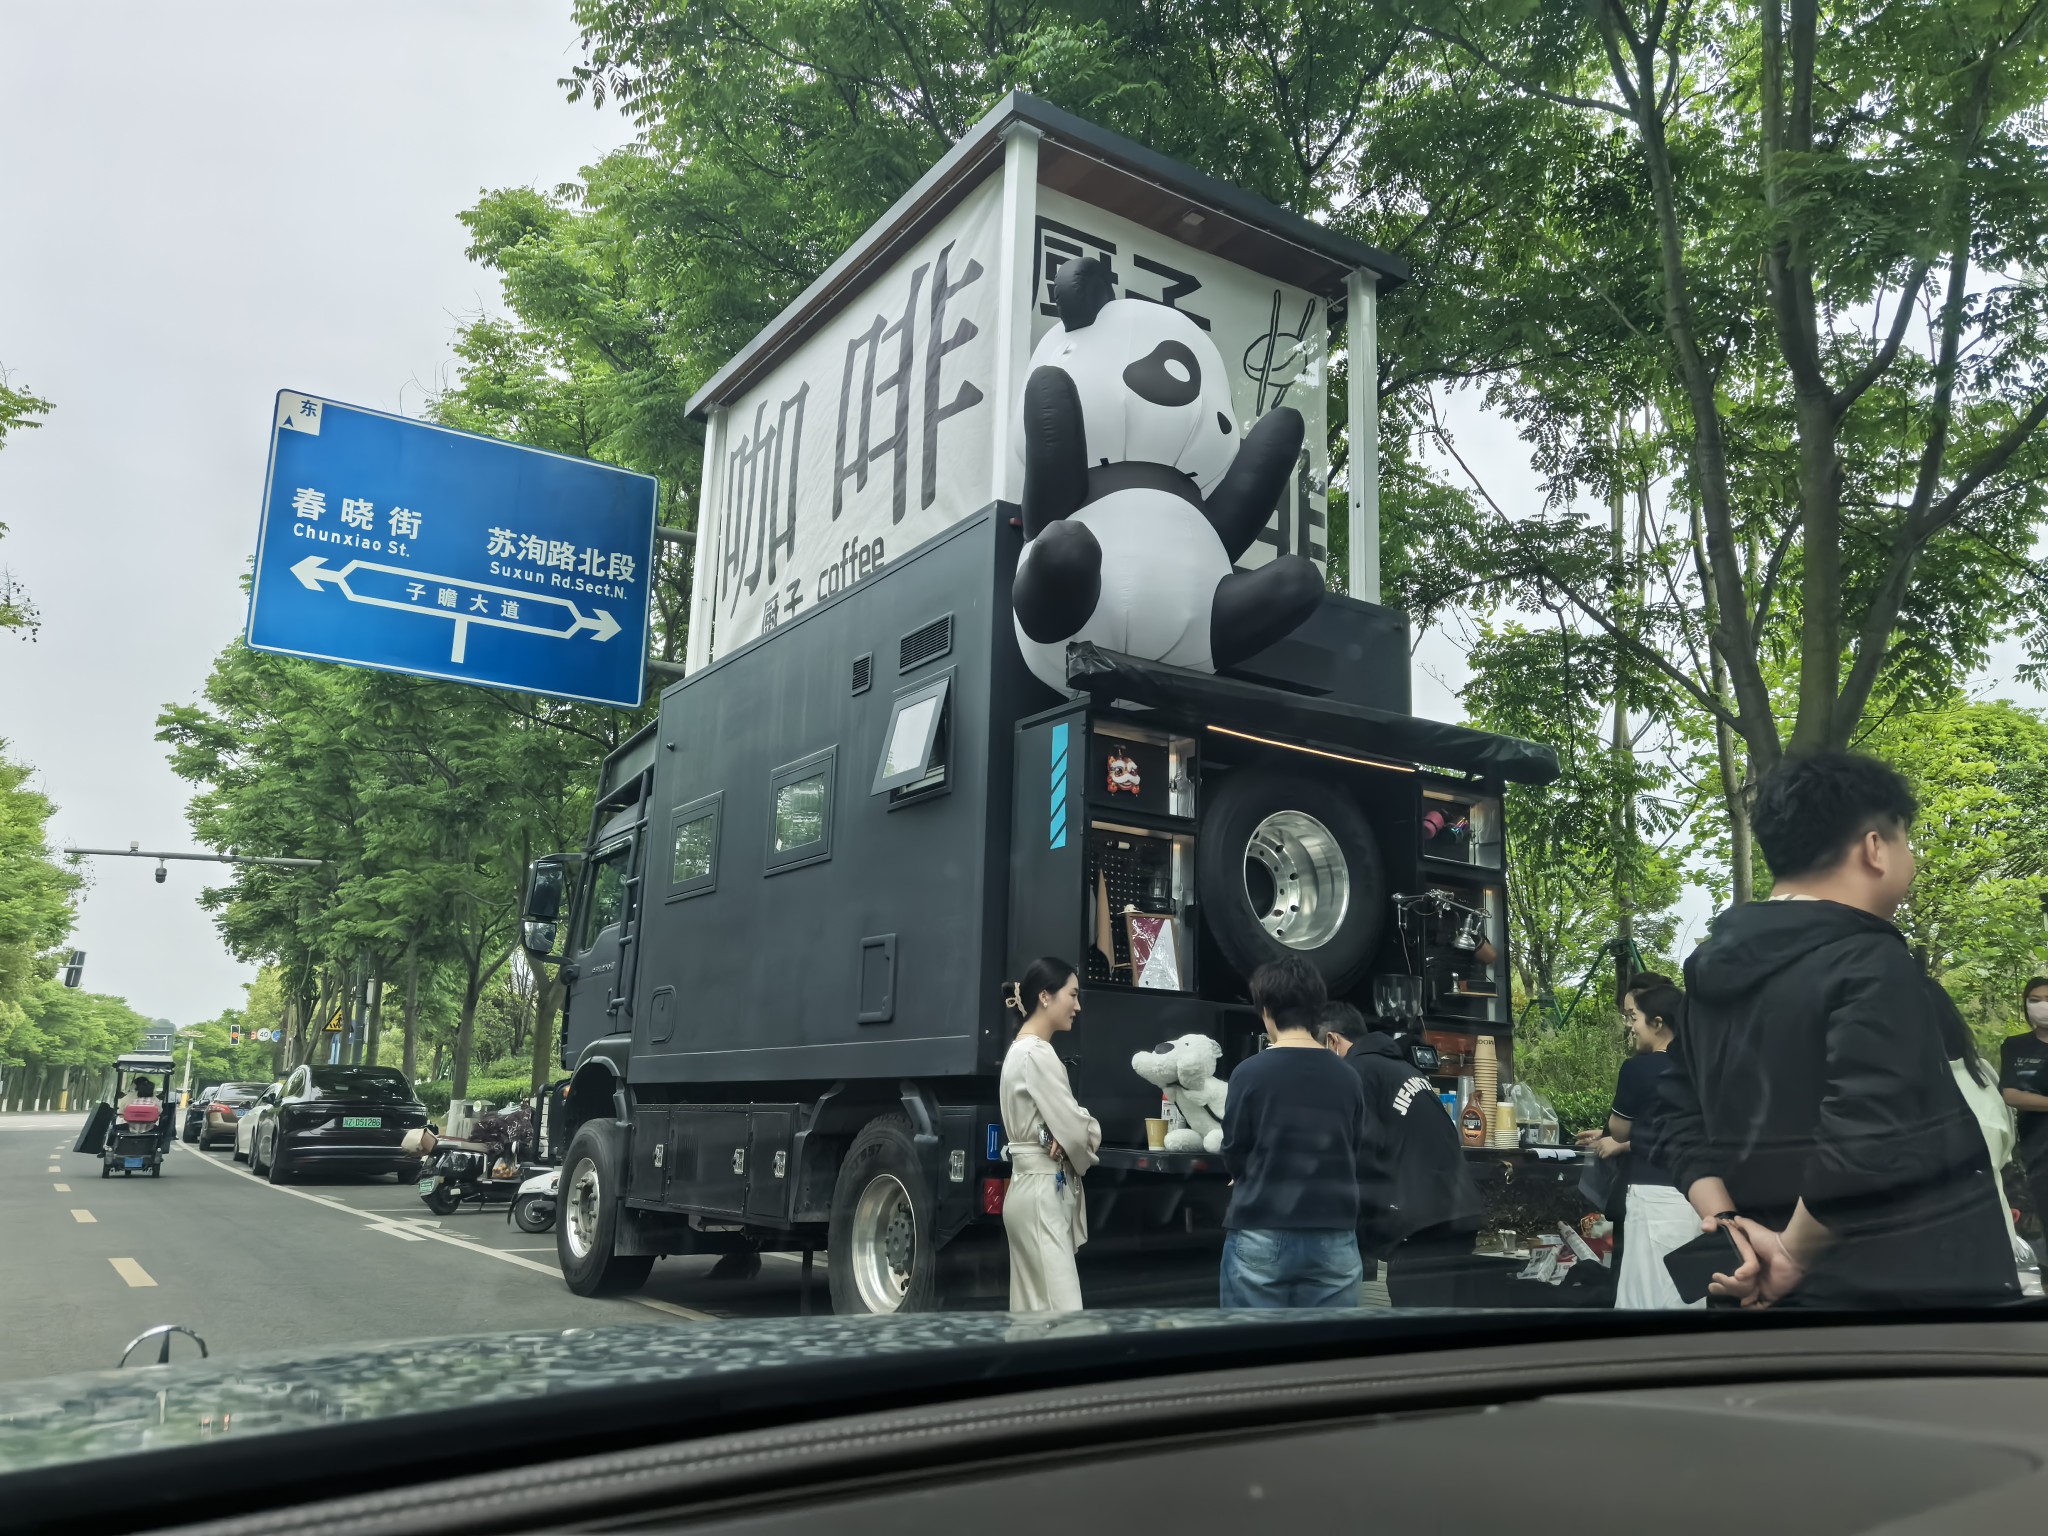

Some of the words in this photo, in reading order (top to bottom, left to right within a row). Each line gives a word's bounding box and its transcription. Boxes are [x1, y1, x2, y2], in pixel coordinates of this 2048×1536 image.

[300, 399, 318, 418] 东
[721, 239, 984, 619] 咖啡
[291, 487, 422, 541] 春晓街
[293, 523, 382, 552] Chunxiao
[388, 540, 411, 558] St.
[486, 526, 637, 584] 苏洵路北段
[490, 561, 545, 584] Suxun
[817, 535, 885, 602] coffee
[406, 581, 520, 620] 子瞻大道
